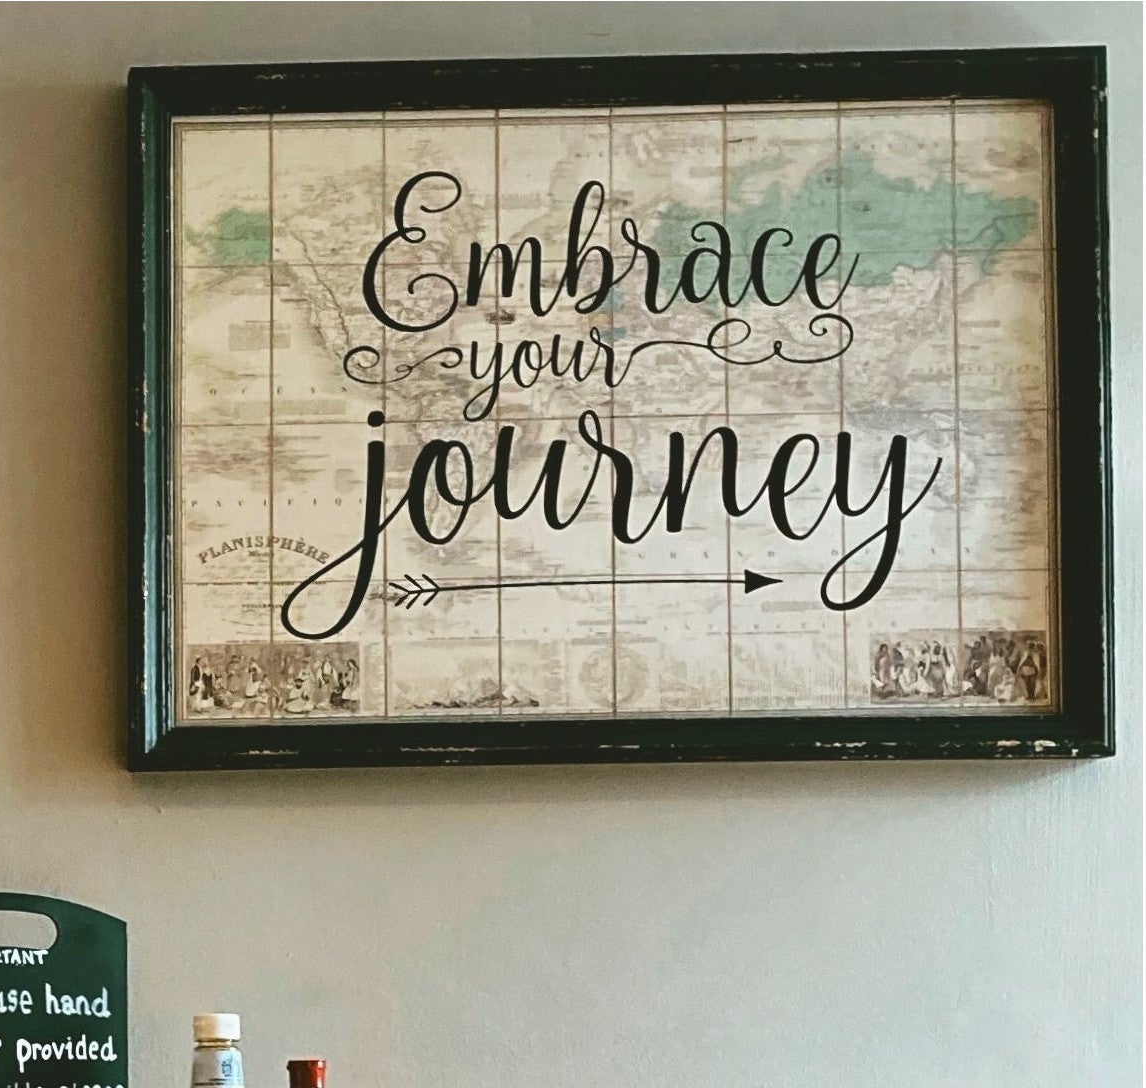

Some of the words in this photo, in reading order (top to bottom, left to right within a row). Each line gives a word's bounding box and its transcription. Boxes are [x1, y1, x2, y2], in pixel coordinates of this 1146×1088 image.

[363, 171, 859, 333] Embrace
[281, 409, 943, 640] journey
[197, 534, 331, 565] PLANISPHÈRE
[44, 981, 112, 1019] hand
[16, 1034, 118, 1074] provided
